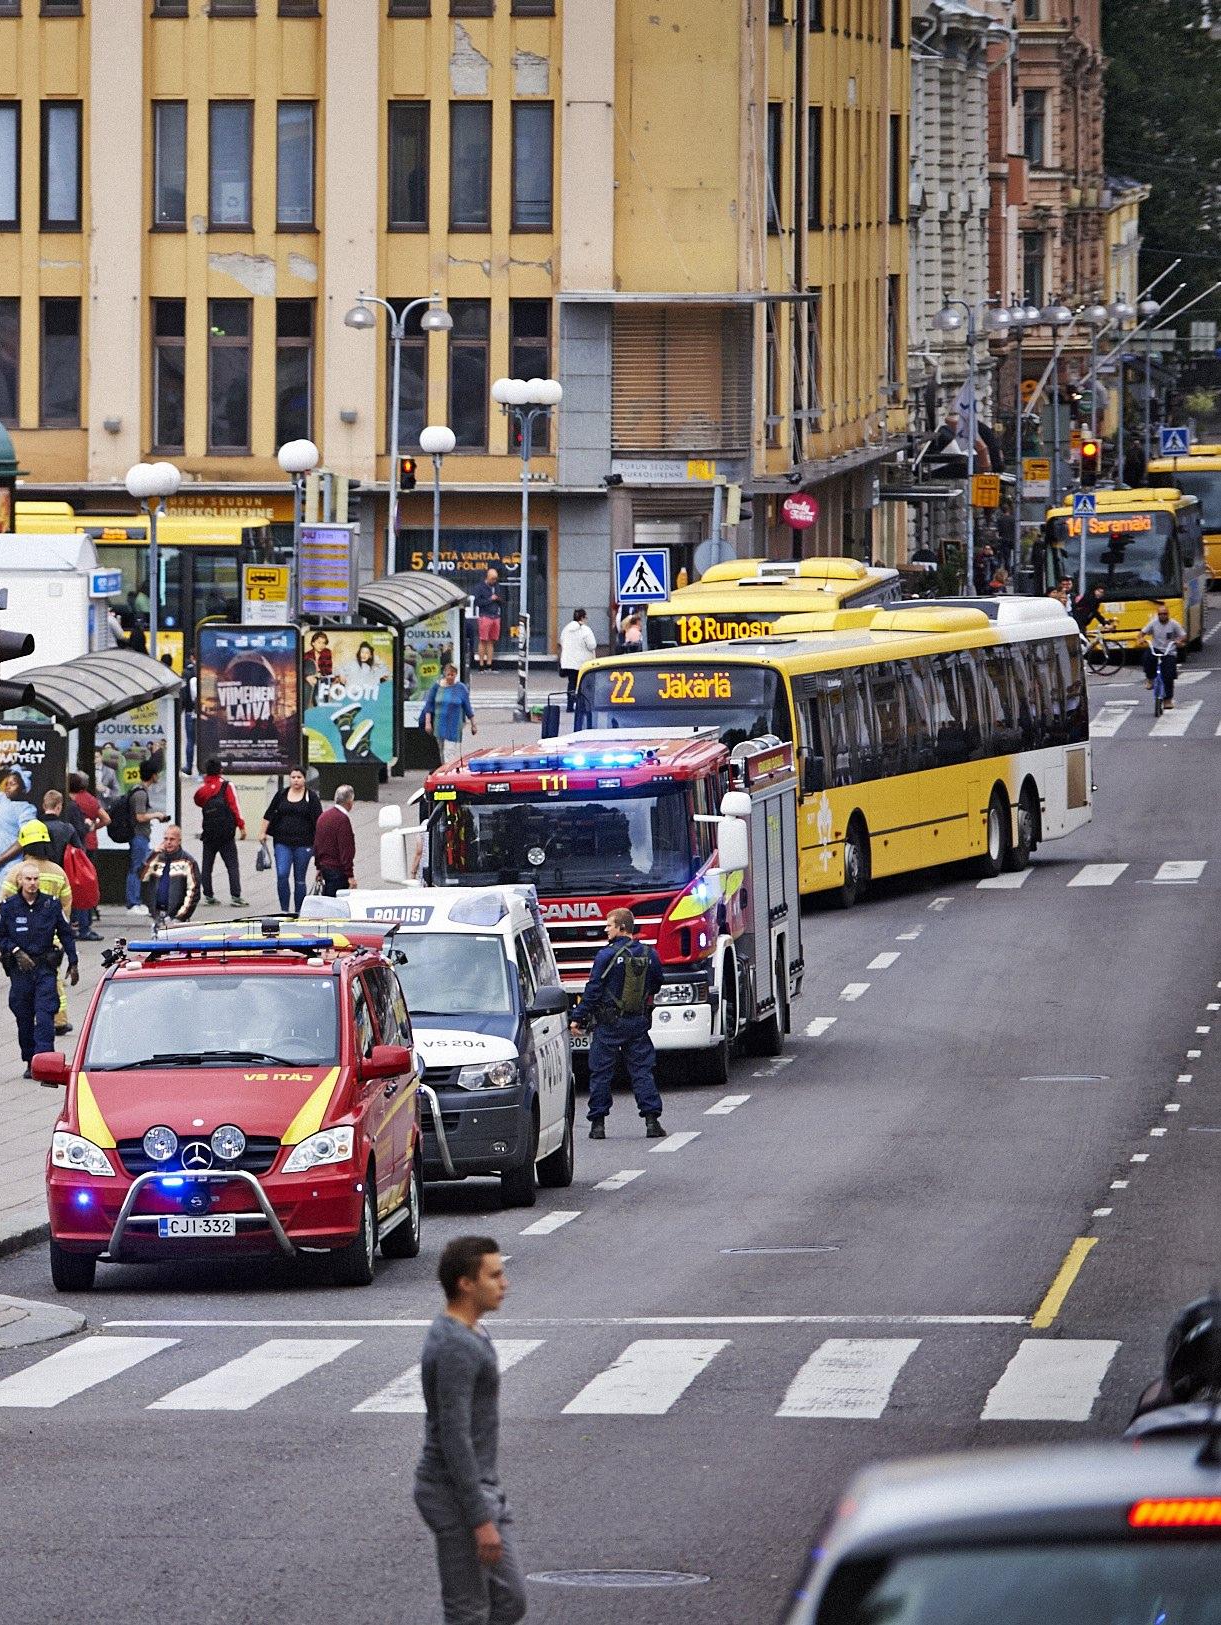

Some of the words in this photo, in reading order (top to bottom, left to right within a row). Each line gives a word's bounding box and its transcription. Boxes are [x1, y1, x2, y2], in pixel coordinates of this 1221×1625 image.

[168, 507, 274, 519] OUKKOLIIKENNE
[411, 552, 425, 571] 5
[427, 551, 458, 561] SYTÄ
[427, 561, 456, 571] ATO
[677, 615, 703, 644] 18
[609, 671, 636, 703] 22
[657, 671, 732, 699] Jäkärlä
[538, 774, 569, 791] T11
[373, 907, 427, 922] POLIISI
[536, 903, 604, 920] CANIA
[423, 1040, 449, 1048] VS
[451, 1040, 487, 1049] 204
[243, 1073, 269, 1081] VS
[170, 1219, 232, 1234] CJI-332
